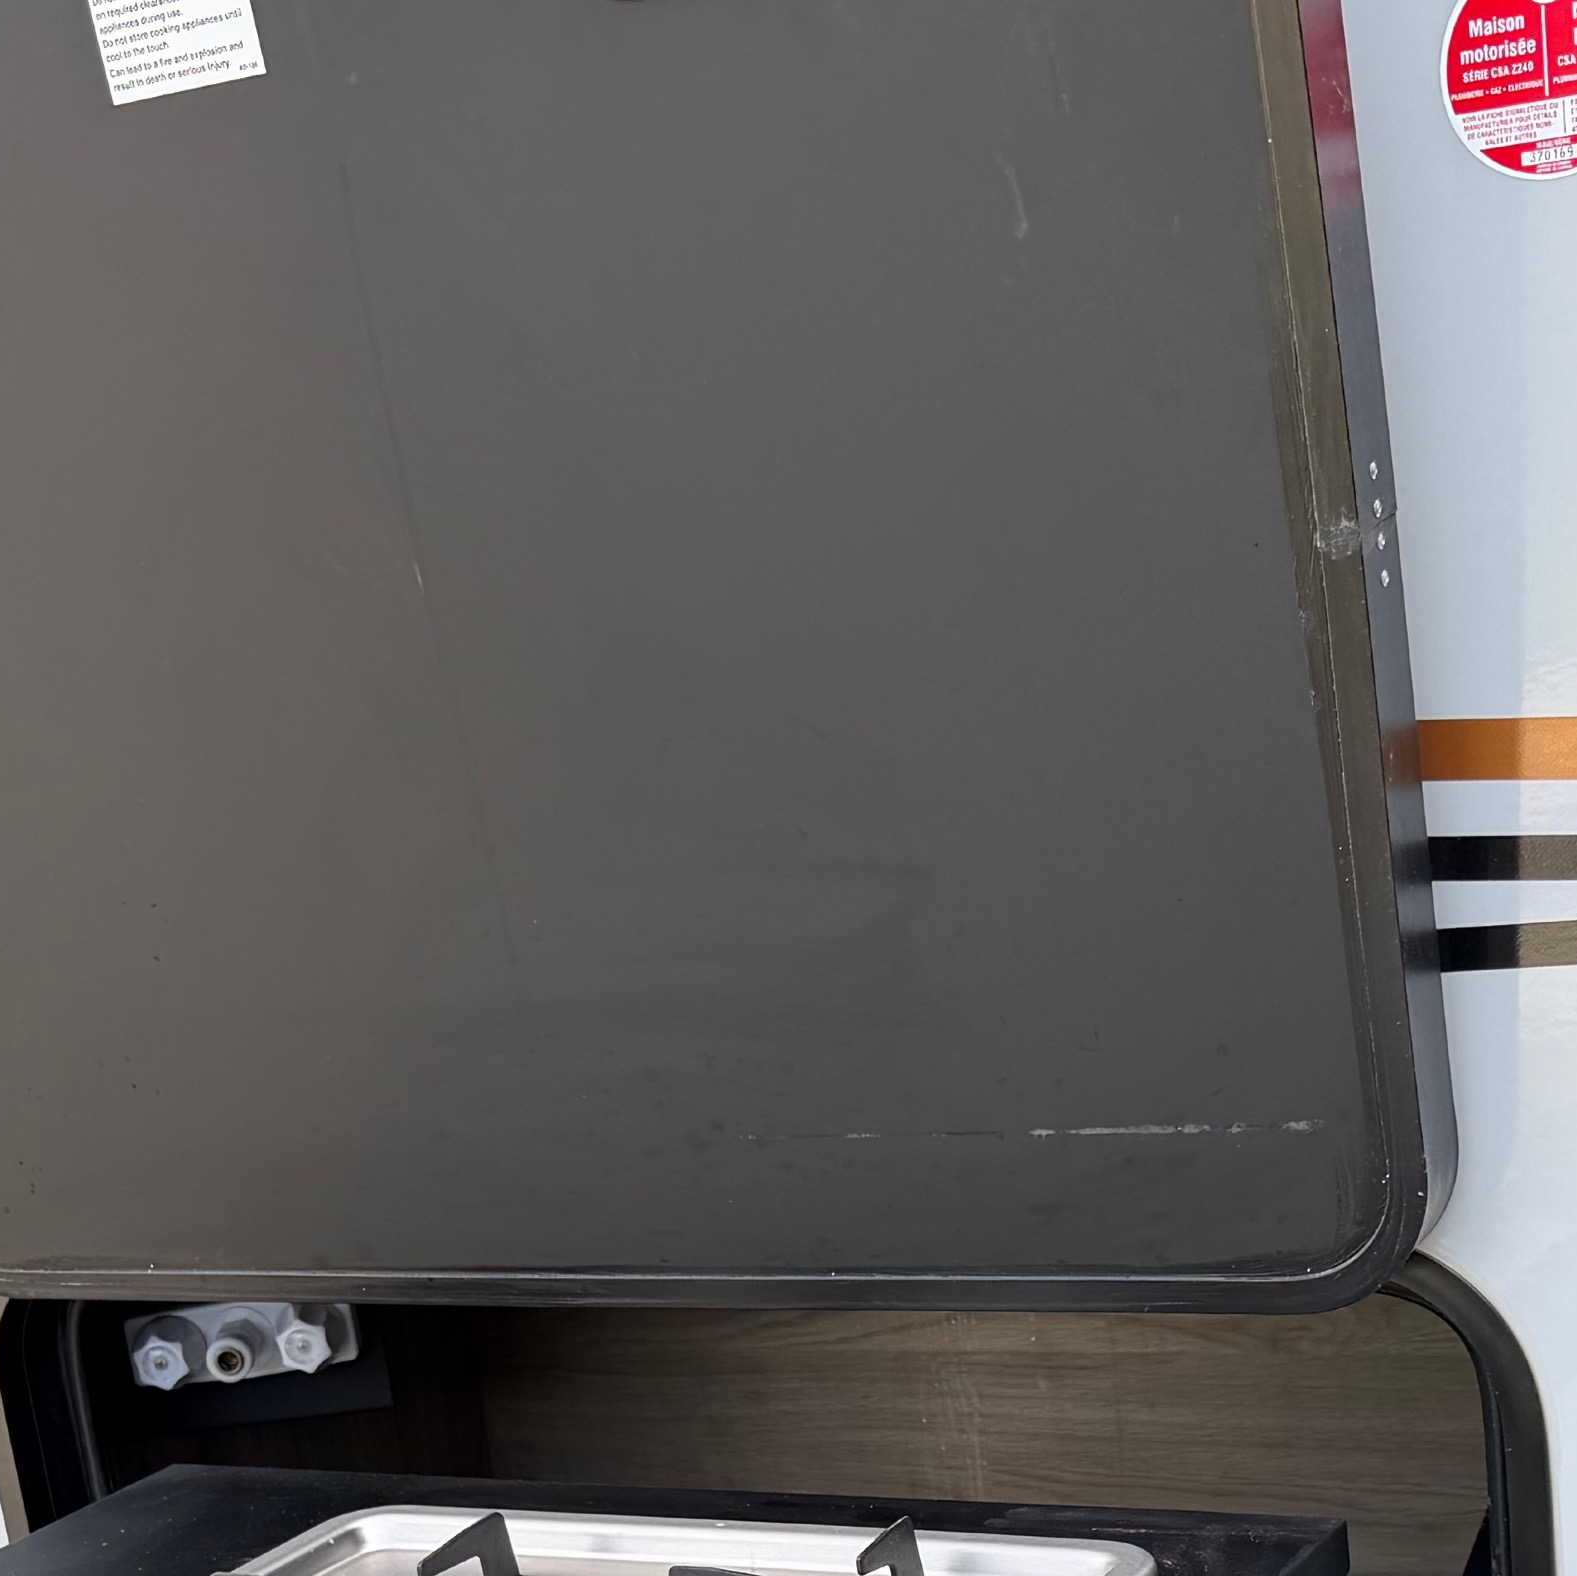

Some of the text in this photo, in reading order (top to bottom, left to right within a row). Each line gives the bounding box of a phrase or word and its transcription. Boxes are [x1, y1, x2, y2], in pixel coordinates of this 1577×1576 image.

[106, 2, 139, 17] required
[100, 20, 139, 36] appliances
[141, 12, 165, 25] during
[102, 8, 242, 48] Do not store cooking appliances until
[1468, 15, 1525, 38] Maison
[106, 51, 122, 62] cool
[123, 50, 132, 58] to
[133, 47, 145, 56] the
[109, 69, 125, 78] Can
[126, 63, 142, 74] lead
[143, 62, 152, 70] to
[159, 58, 172, 67] fire
[174, 52, 189, 64] and
[190, 45, 228, 60] explosion
[229, 40, 243, 51] and
[1460, 37, 1536, 65] motorisée
[1557, 53, 1577, 67] CSA
[113, 80, 135, 92] result
[145, 73, 167, 85] death
[167, 71, 176, 80] or
[178, 65, 206, 78] serious
[1491, 65, 1510, 79] CSA
[1512, 60, 1534, 75] Z240
[1529, 146, 1574, 162] 370169
